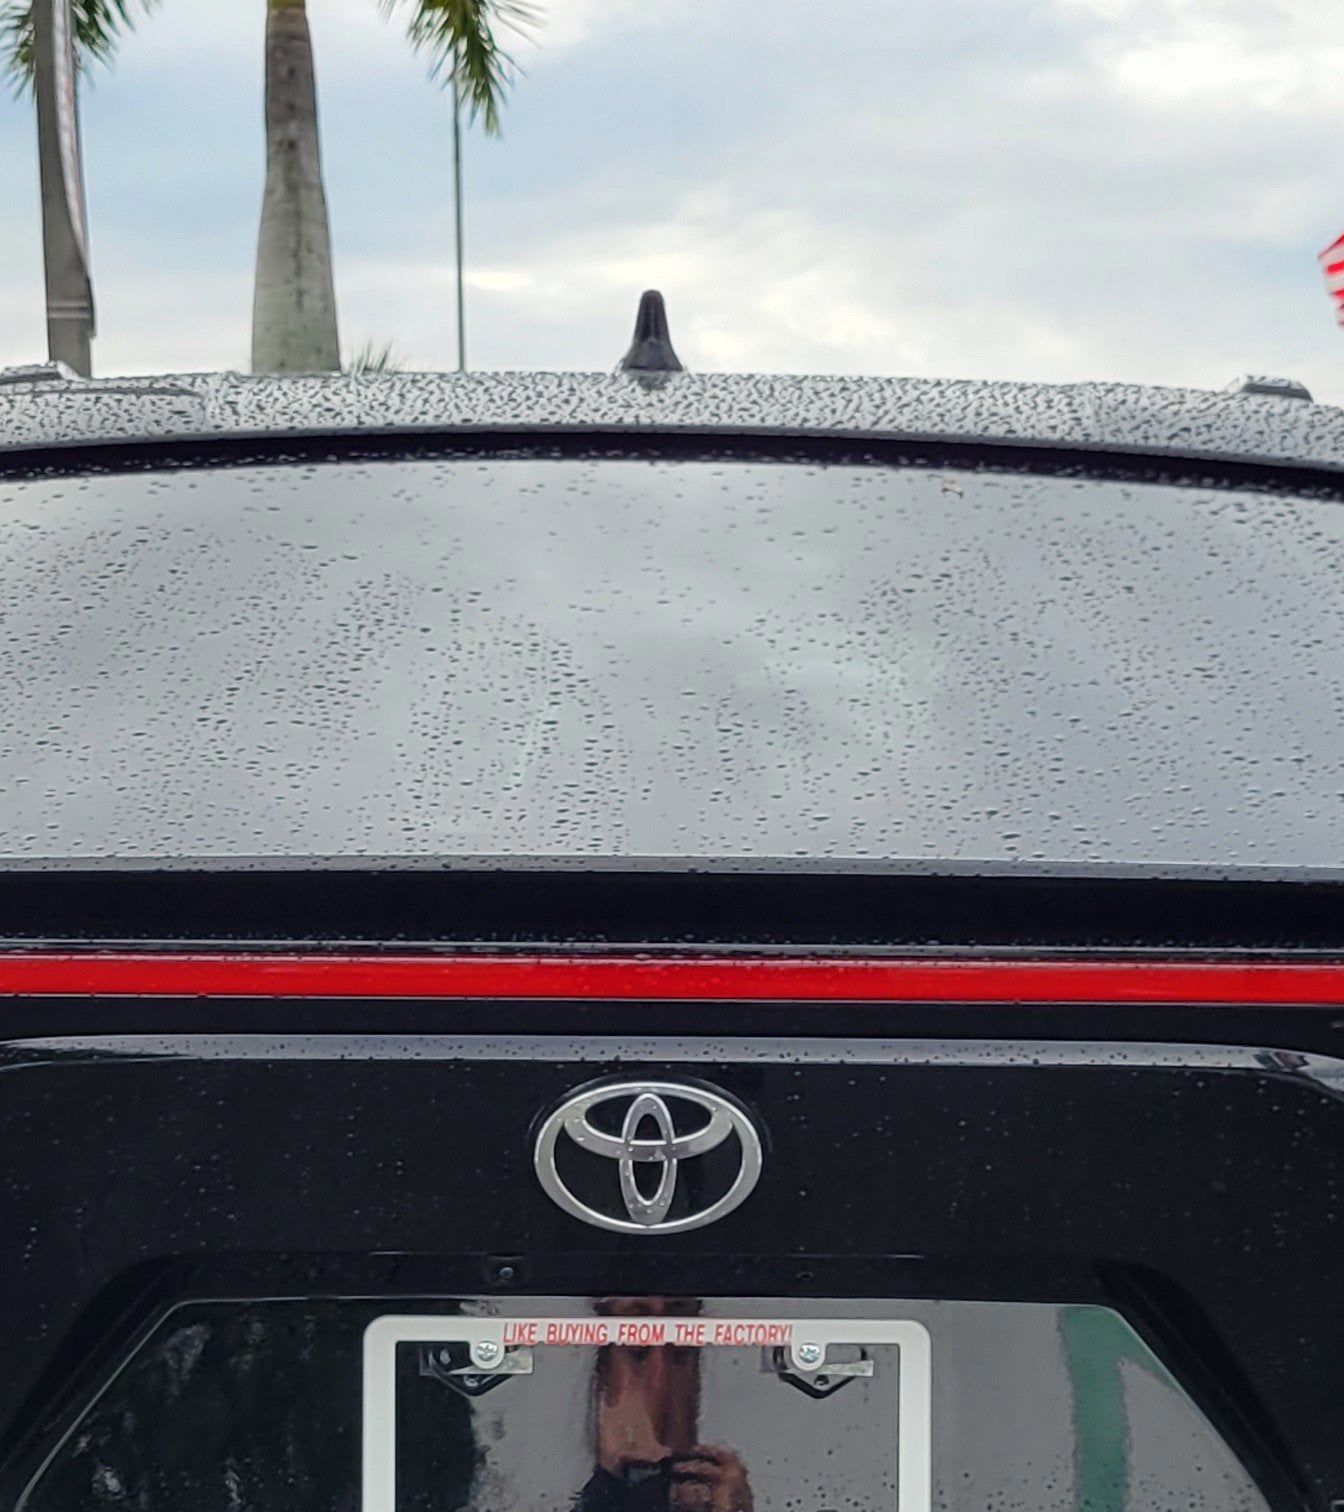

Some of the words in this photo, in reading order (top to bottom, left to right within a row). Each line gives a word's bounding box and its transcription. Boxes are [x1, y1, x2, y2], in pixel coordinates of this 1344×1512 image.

[504, 1323, 536, 1343] LIKE
[547, 1323, 606, 1343] BUYING
[617, 1324, 665, 1344] FROM
[674, 1324, 704, 1344] THE
[714, 1324, 793, 1345] FACTORY!
